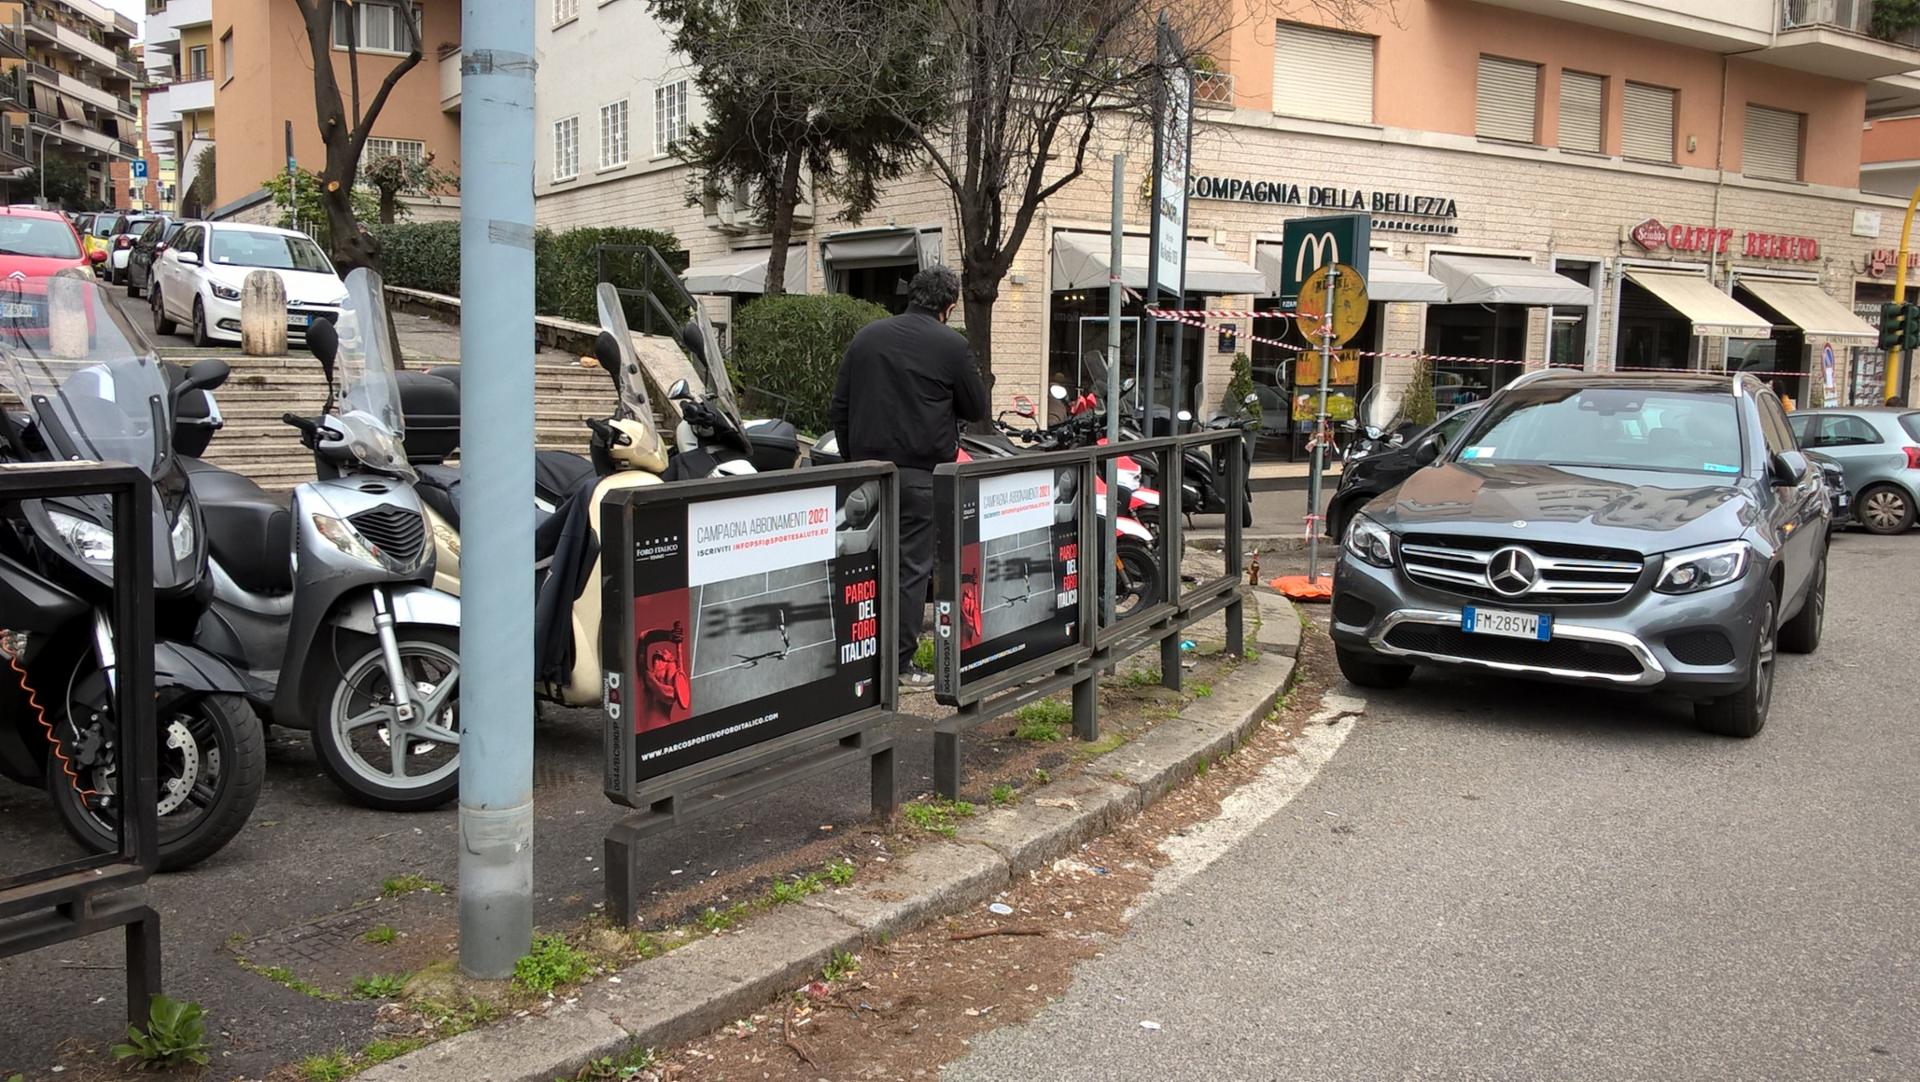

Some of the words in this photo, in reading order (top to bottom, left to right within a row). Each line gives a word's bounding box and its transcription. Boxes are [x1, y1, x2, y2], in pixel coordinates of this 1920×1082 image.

[135, 162, 145, 177] P
[1308, 186, 1365, 209] DELLA
[1372, 191, 1458, 218] BELLEZZA
[1371, 219, 1459, 234] PARRUCCHIERI
[697, 520, 748, 544] CAMPAGNA
[750, 510, 807, 536] ABBONAMENTI
[808, 507, 830, 525] 2021
[697, 545, 732, 557] ISCRIVITI
[1059, 544, 1077, 562] PARCO
[1066, 559, 1077, 575] DEL
[845, 580, 876, 605] PARCO
[1063, 575, 1077, 592] FORO
[858, 599, 876, 621] DEL
[852, 618, 876, 642] FORO
[841, 637, 877, 665] ITALICO
[640, 712, 779, 762] WWW.PARCOSPORTIVOFOROITALICO.COM
